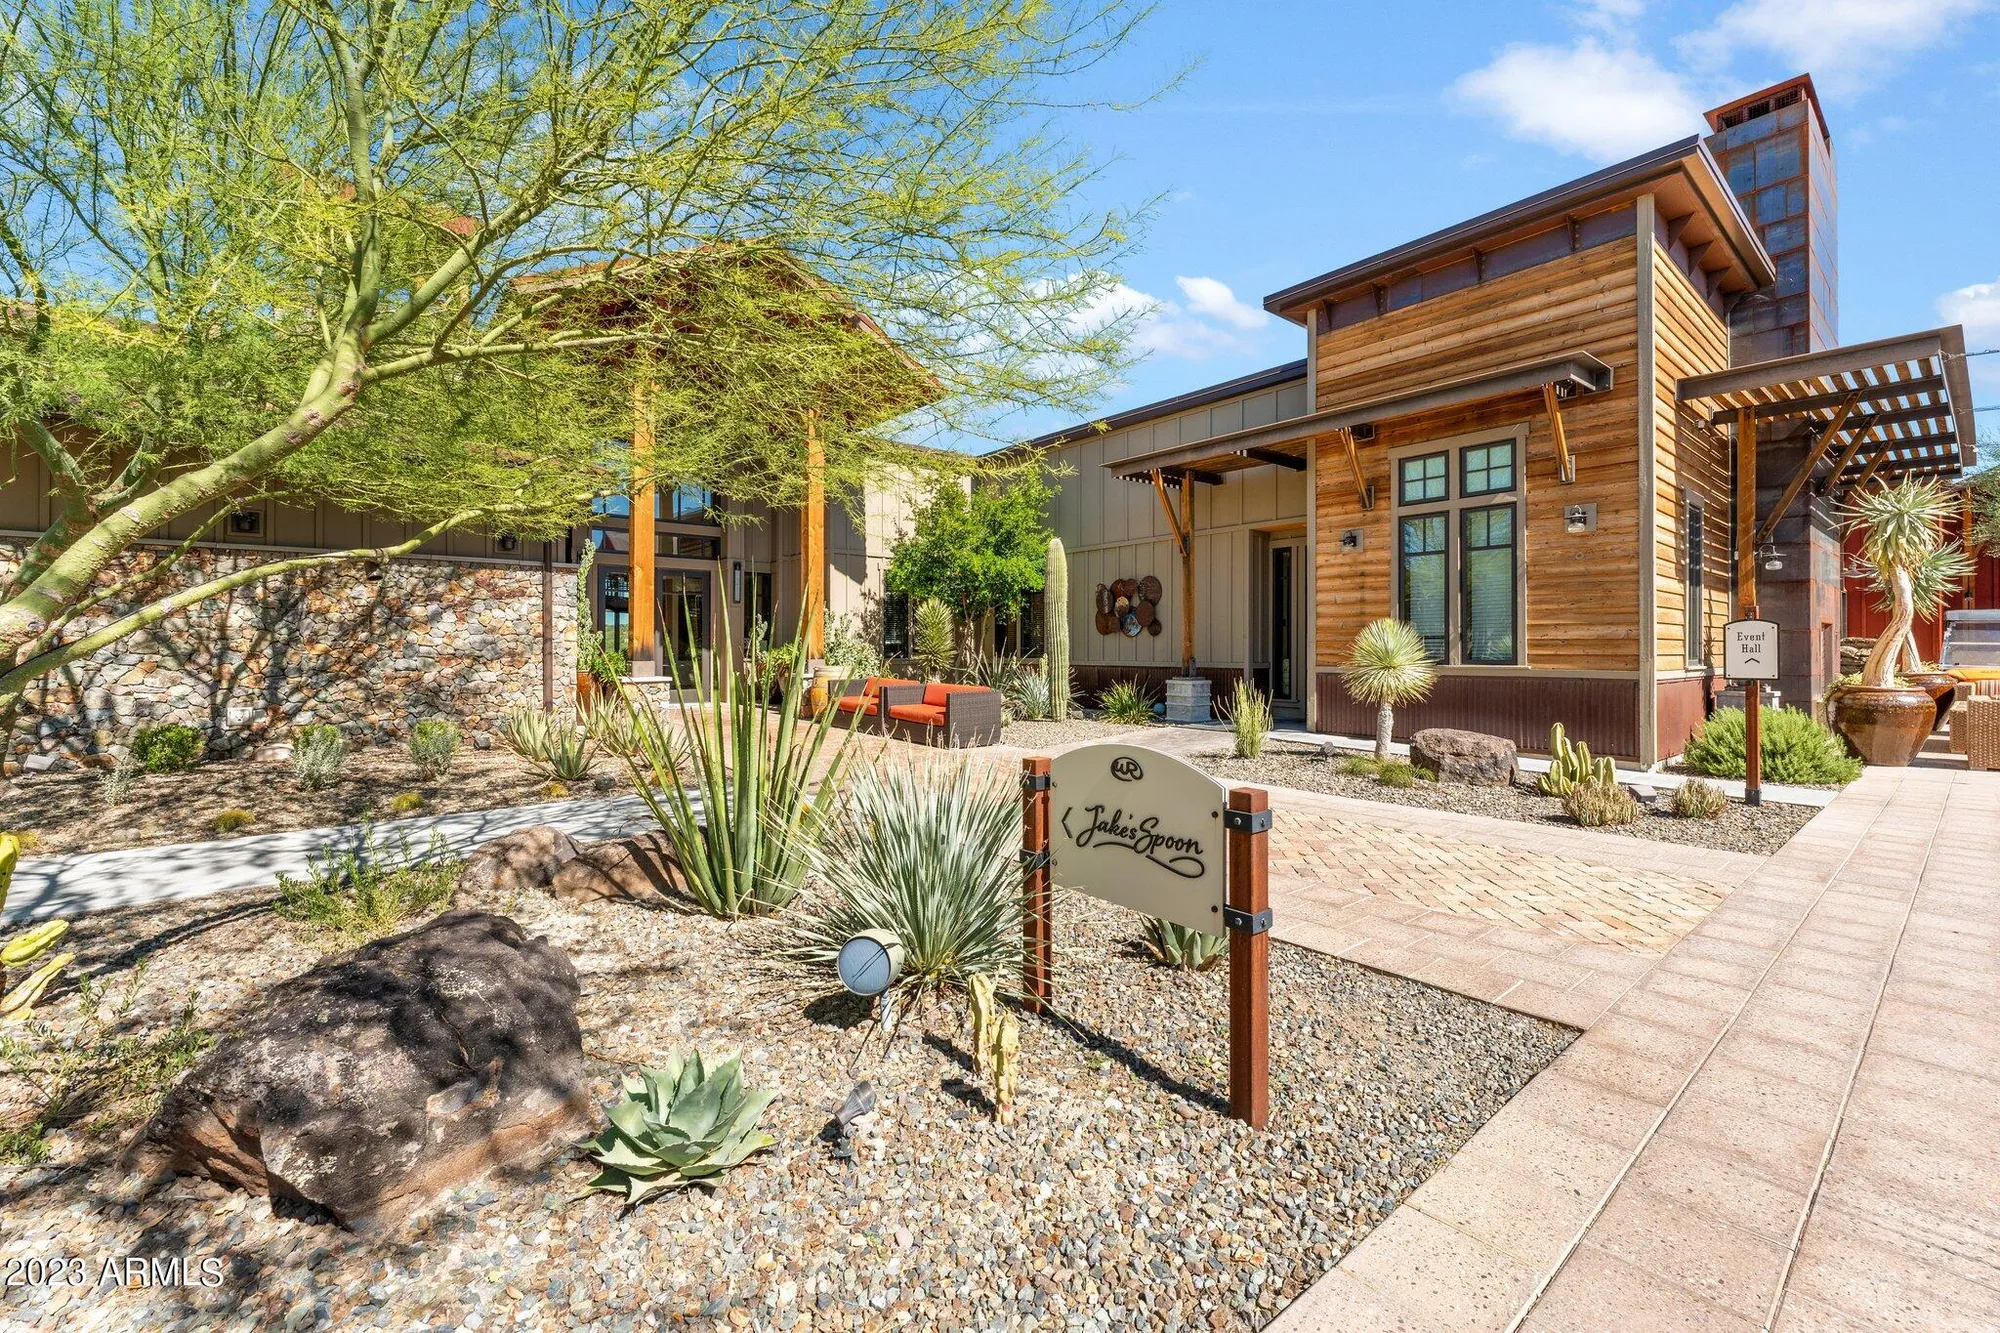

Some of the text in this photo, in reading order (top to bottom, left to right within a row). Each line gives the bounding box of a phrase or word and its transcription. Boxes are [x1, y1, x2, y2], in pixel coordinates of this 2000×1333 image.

[1737, 631, 1765, 641] Event
[1741, 644, 1761, 653] Hall
[1076, 805, 1204, 854] Jake's Spoon
